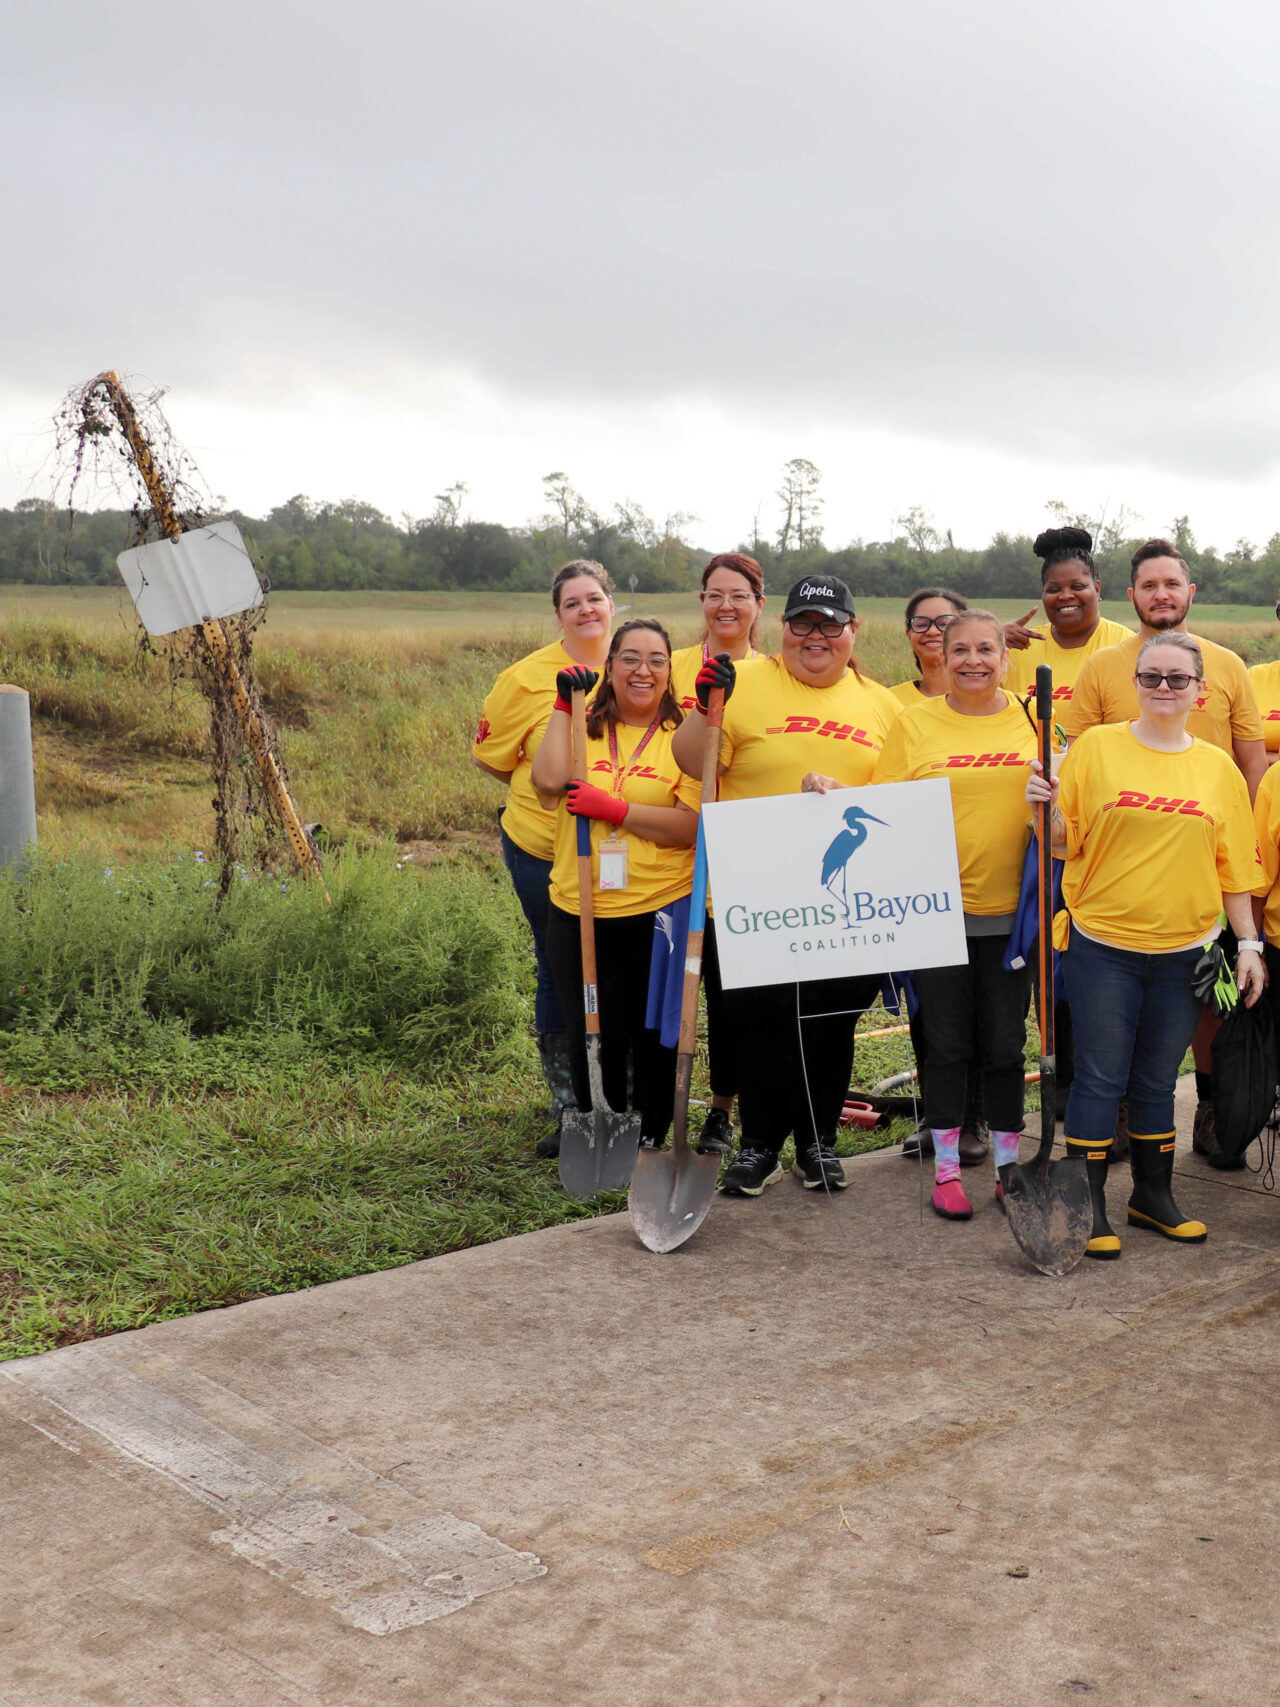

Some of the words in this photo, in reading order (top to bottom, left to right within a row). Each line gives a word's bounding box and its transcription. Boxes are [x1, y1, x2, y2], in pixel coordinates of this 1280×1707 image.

[783, 716, 873, 748] DHL
[945, 752, 1029, 768] DHL
[1114, 790, 1206, 817] DHL
[725, 903, 836, 935] Greens
[853, 891, 952, 926] Bayou
[789, 932, 896, 953] COALITION
